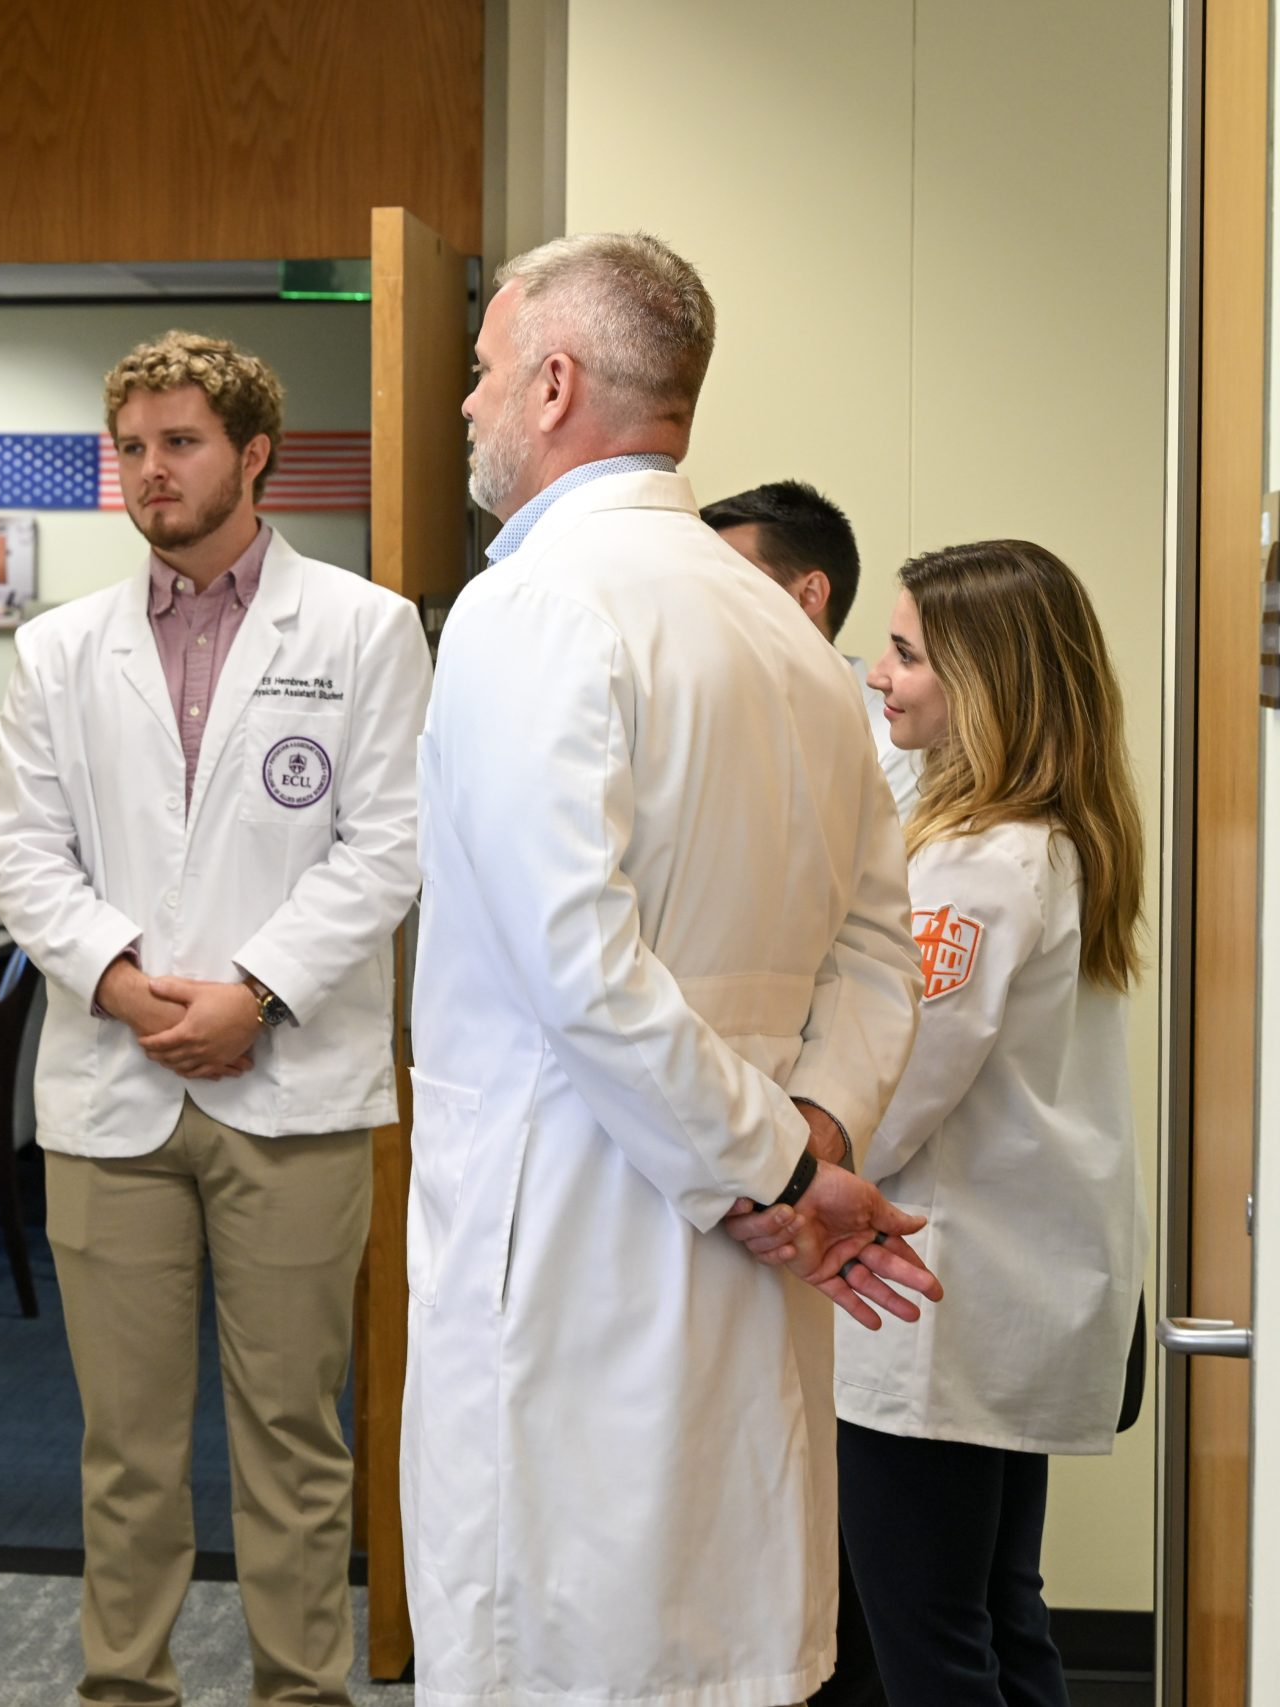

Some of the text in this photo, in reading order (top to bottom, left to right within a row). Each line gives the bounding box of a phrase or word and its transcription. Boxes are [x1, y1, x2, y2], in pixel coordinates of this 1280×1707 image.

[275, 678, 310, 687] Hembree,
[314, 679, 333, 689] PA-S
[284, 688, 317, 698] Assistant
[319, 690, 344, 701] Student
